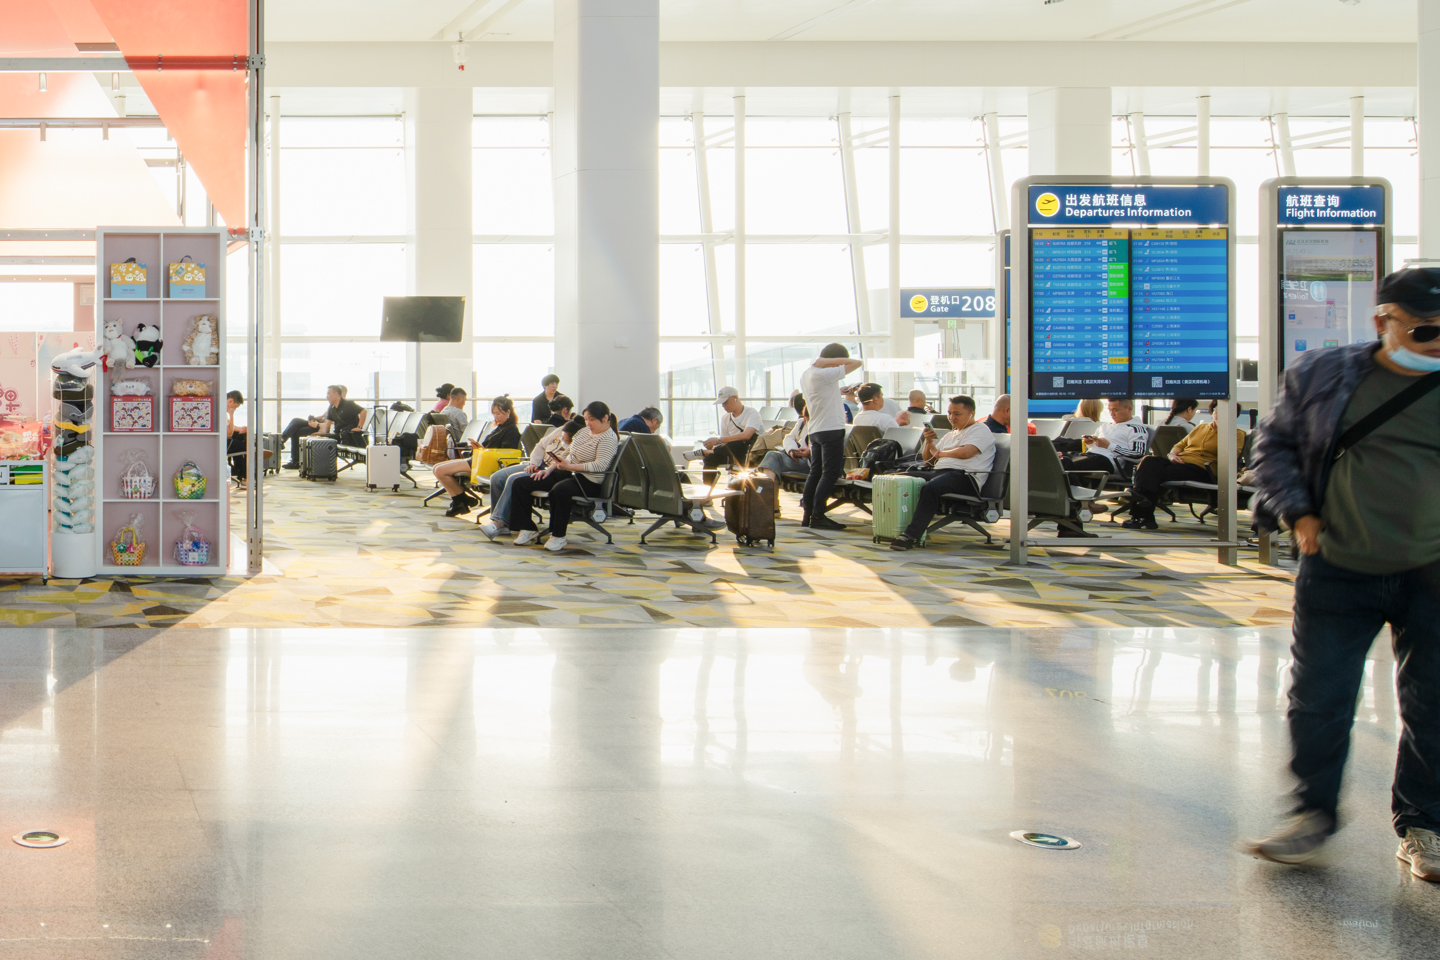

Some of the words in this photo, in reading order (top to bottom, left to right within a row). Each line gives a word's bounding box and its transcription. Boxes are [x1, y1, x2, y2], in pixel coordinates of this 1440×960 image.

[1065, 193, 1147, 207] 出发航班信息
[1286, 194, 1339, 208] 航班查询
[1065, 207, 1125, 219] Departures
[1127, 207, 1191, 218] Information
[1286, 207, 1314, 219] Flight
[1316, 207, 1376, 218] Information
[930, 295, 960, 305] 登机口
[961, 296, 996, 312] 208
[930, 305, 949, 313] Gate
